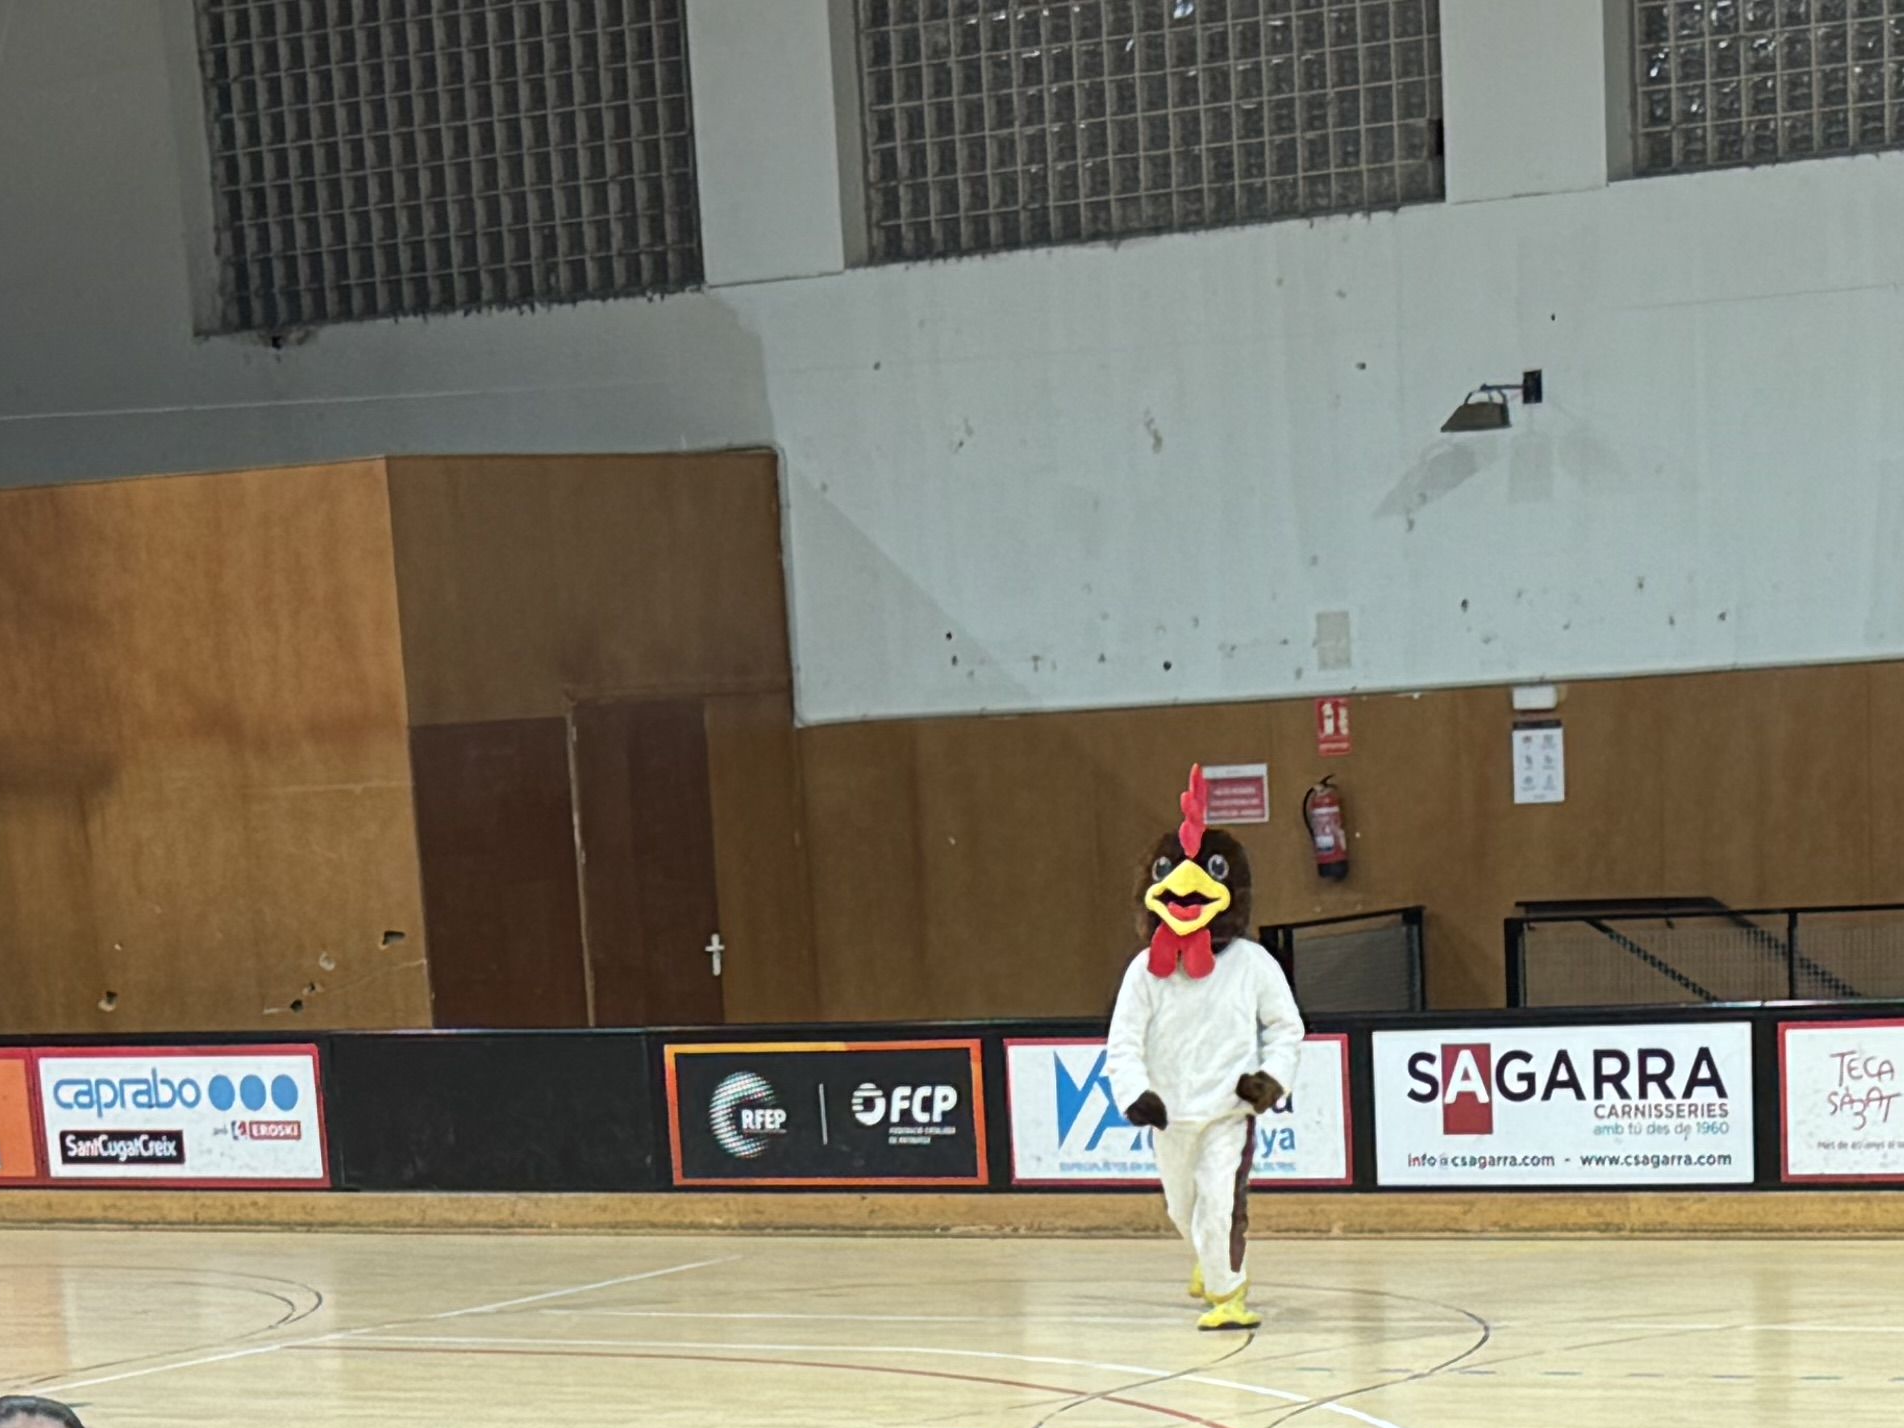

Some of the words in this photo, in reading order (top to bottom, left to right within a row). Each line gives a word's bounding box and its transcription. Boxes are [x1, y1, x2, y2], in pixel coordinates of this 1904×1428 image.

[1406, 1046, 1730, 1104] SAGARRA
[1829, 1050, 1895, 1087] TECA
[53, 1067, 202, 1119] caprabo
[889, 1085, 959, 1124] FCP
[741, 1108, 788, 1131] RFEP
[1594, 1103, 1730, 1119] CARNISSERIES
[251, 1123, 299, 1138] EROSKI
[1593, 1122, 1624, 1136] amb
[1646, 1121, 1670, 1135] des
[1696, 1121, 1730, 1135] 1960
[1580, 1152, 1733, 1169] www.csagarra.com
